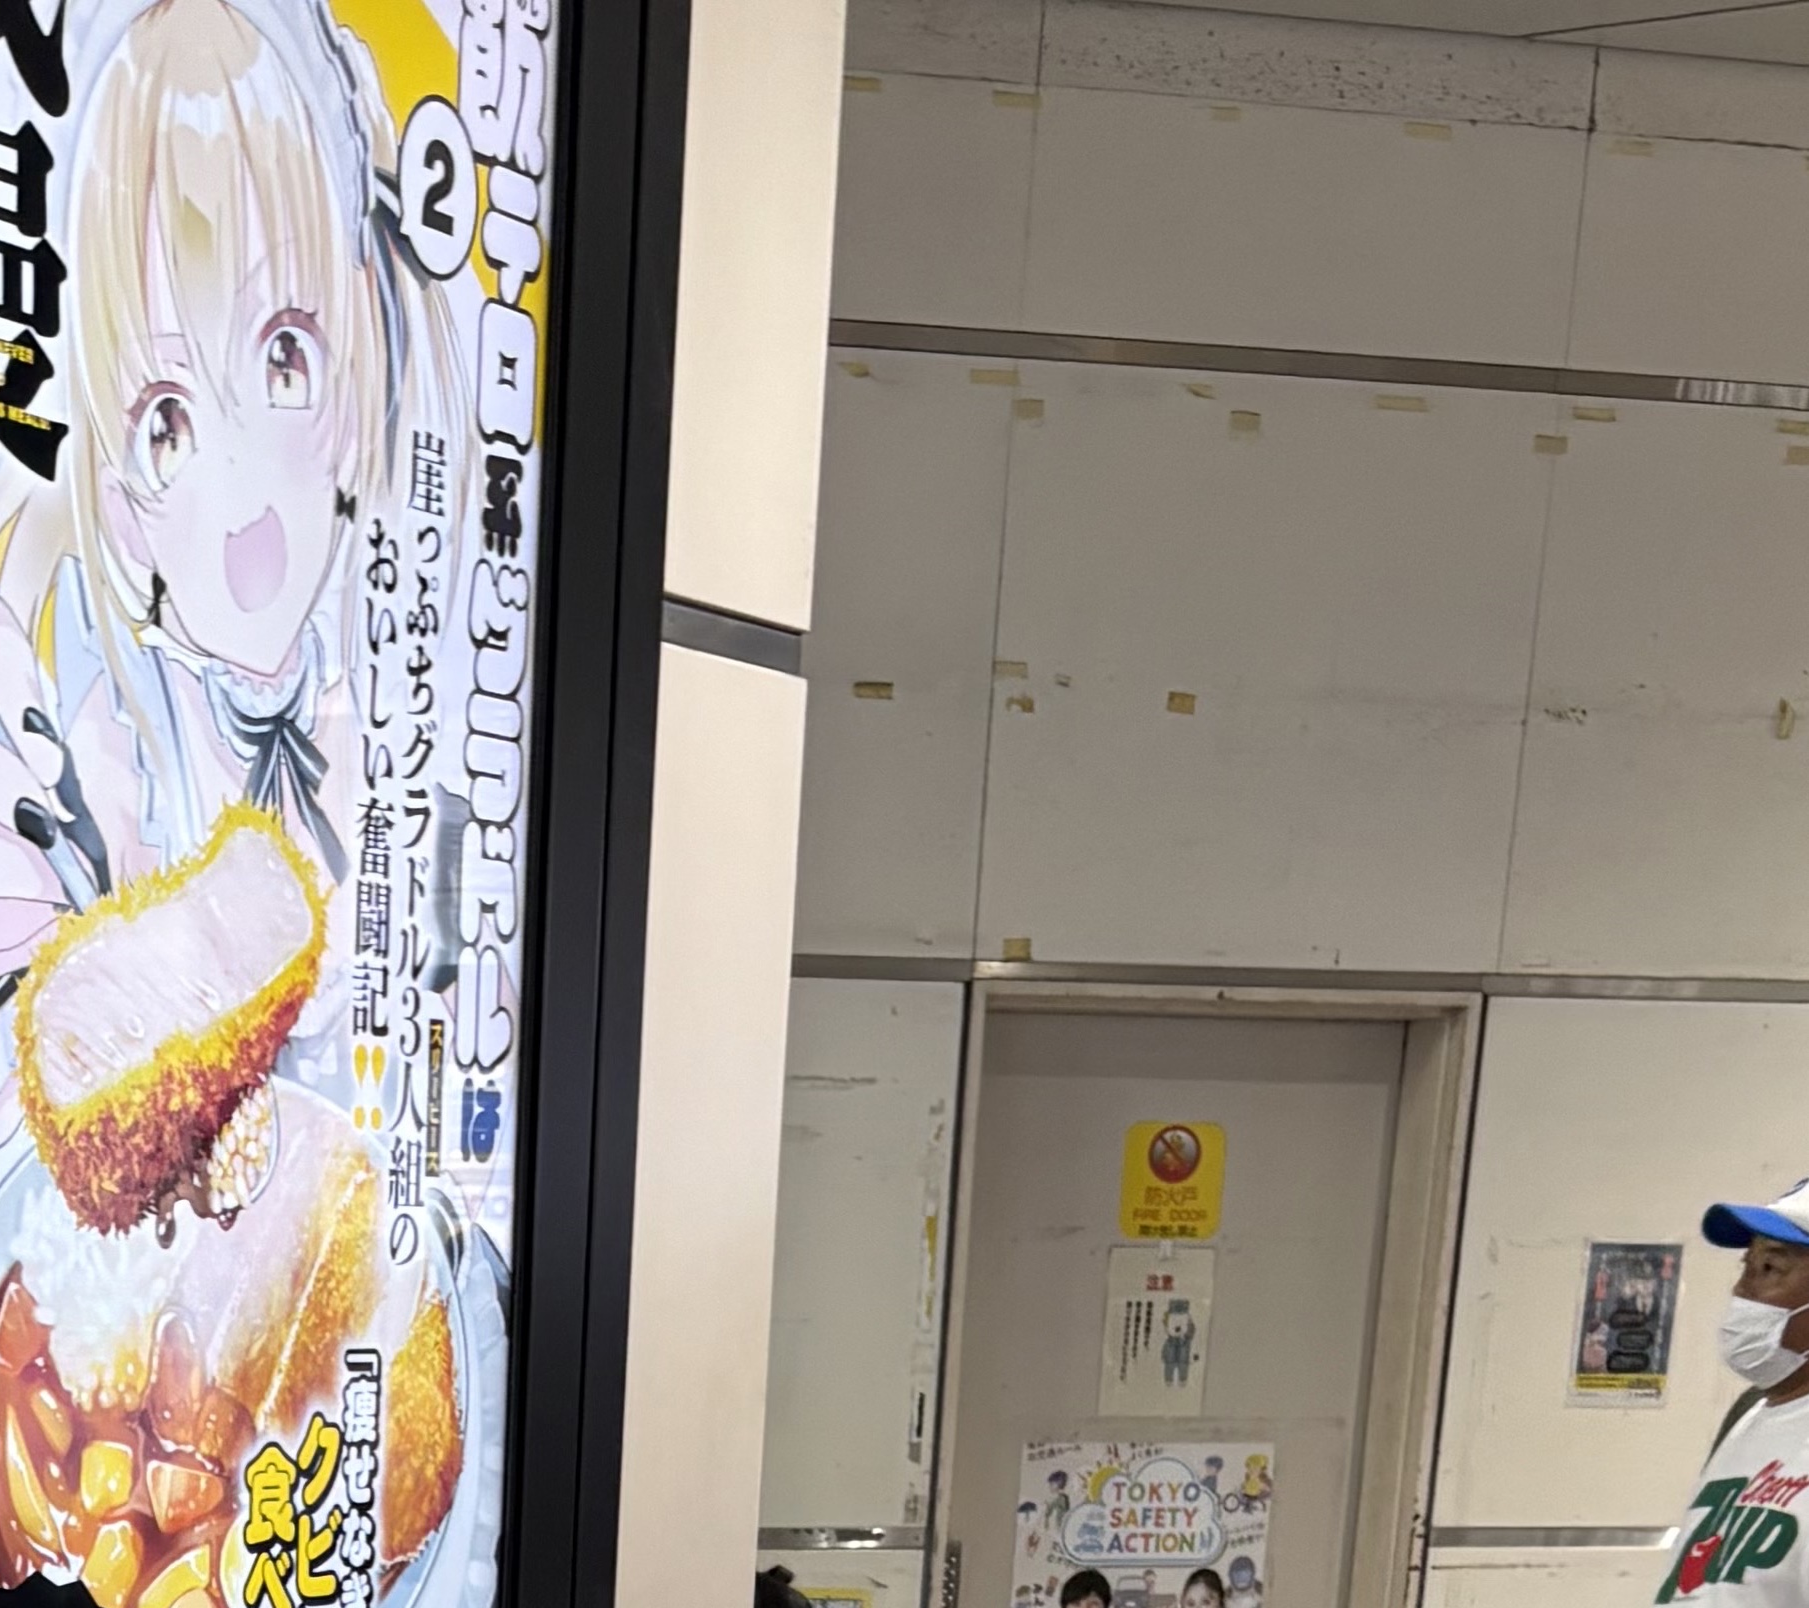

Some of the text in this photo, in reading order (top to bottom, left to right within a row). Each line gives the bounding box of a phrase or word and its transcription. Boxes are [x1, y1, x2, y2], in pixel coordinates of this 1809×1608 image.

[1112, 1480, 1201, 1502] TOKYO
[1109, 1506, 1199, 1529] SAFETY
[1106, 1532, 1196, 1554] ACTION
